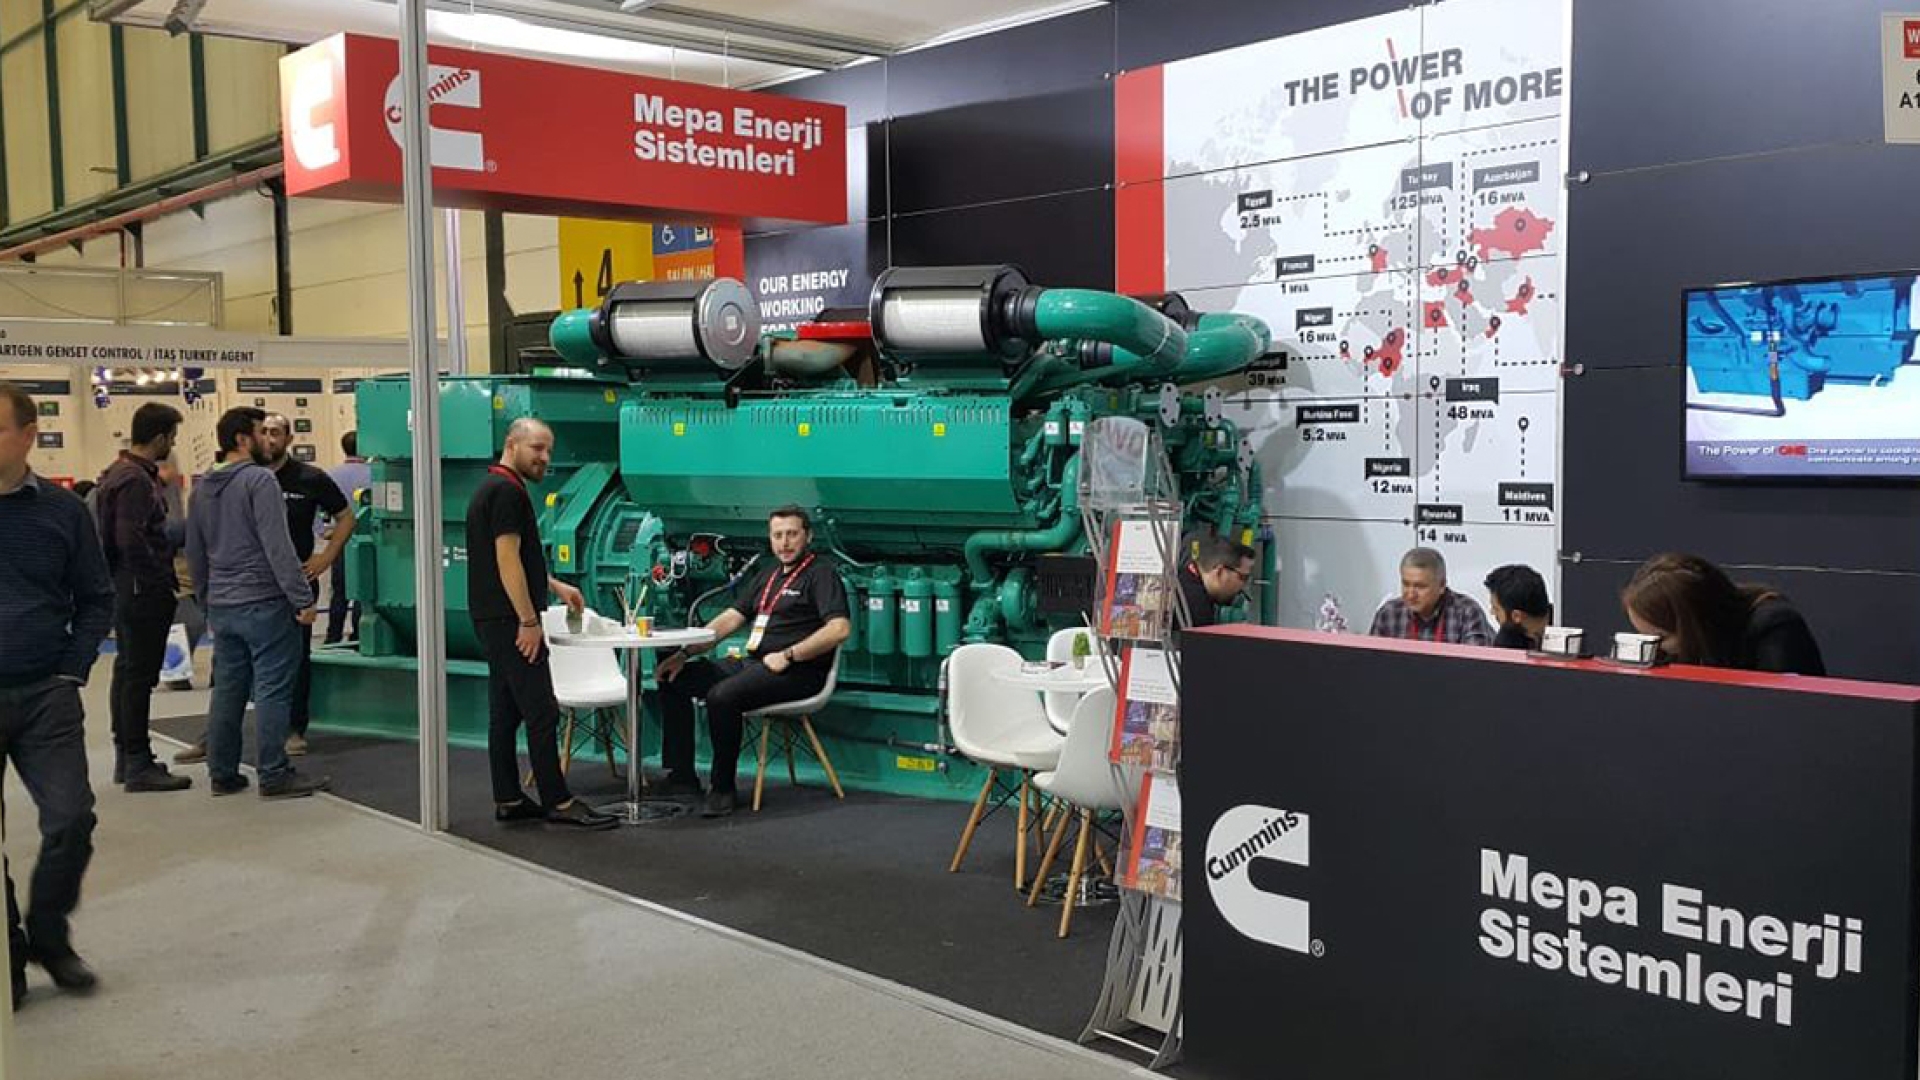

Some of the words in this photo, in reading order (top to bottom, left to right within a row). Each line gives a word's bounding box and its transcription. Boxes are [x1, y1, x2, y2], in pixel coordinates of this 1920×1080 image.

[1284, 73, 1339, 107] THE
[1350, 48, 1463, 95] POWER
[386, 67, 473, 123] Cmins
[1410, 87, 1453, 119] OF
[1463, 67, 1563, 112] MORE
[634, 93, 724, 135] Mepa
[733, 107, 822, 150] Enerji
[634, 129, 796, 176] Sistemleri
[1407, 172, 1439, 184] Tukey
[1390, 195, 1417, 211] 125
[1420, 194, 1444, 205] MVA
[1479, 192, 1498, 206] 16
[1500, 192, 1526, 203] MVA
[1240, 214, 1260, 229] 2.5
[597, 249, 613, 297] 4
[760, 276, 788, 294] OUR
[792, 268, 849, 292] ENERGY
[1281, 283, 1287, 295] 1
[760, 296, 825, 318] WORKING
[1300, 331, 1315, 344] 16
[1317, 332, 1337, 342] MVA
[46, 346, 87, 358] GENSET
[92, 346, 143, 359] CONTROL
[179, 350, 217, 361] TURKEY
[221, 351, 254, 362] AGENT
[1248, 373, 1266, 385] 39
[1448, 406, 1468, 420] 48
[1470, 409, 1494, 419] MVA
[1303, 428, 1325, 441] 5.2
[1326, 431, 1346, 440] MVA
[1697, 445, 1720, 456] The
[1723, 445, 1760, 456] Power
[1372, 480, 1390, 494] 12
[1391, 484, 1413, 494] MVA
[1503, 509, 1521, 521] 11
[1525, 512, 1550, 522] MVA
[1418, 529, 1436, 542] 14
[1444, 533, 1467, 543] MVA
[1208, 810, 1299, 880] Cummins
[1480, 848, 1639, 926] Mepa
[1661, 882, 1863, 980] Enerji
[1478, 907, 1794, 1027] Sistemleri
